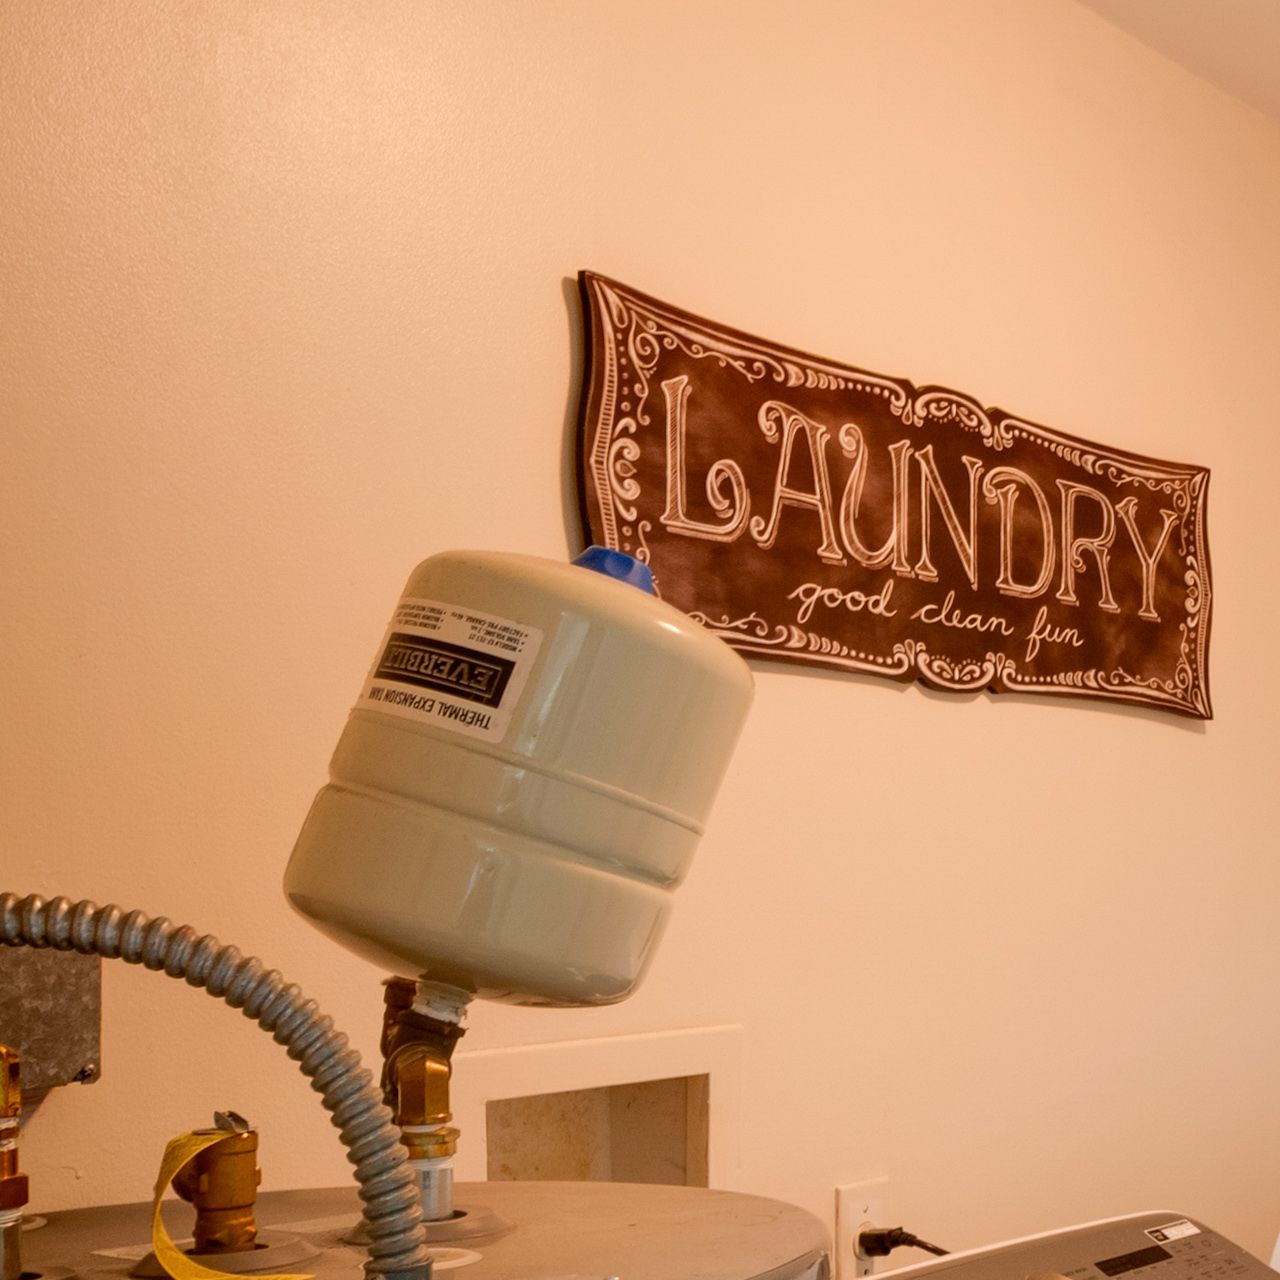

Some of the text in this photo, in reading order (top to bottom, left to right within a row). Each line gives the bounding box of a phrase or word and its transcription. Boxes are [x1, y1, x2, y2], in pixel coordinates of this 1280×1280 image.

[660, 375, 1178, 623] LAUNDRY
[787, 579, 1084, 663] good clean fun
[384, 688, 436, 713] EXPANSION
[438, 706, 492, 730] THERMAL
